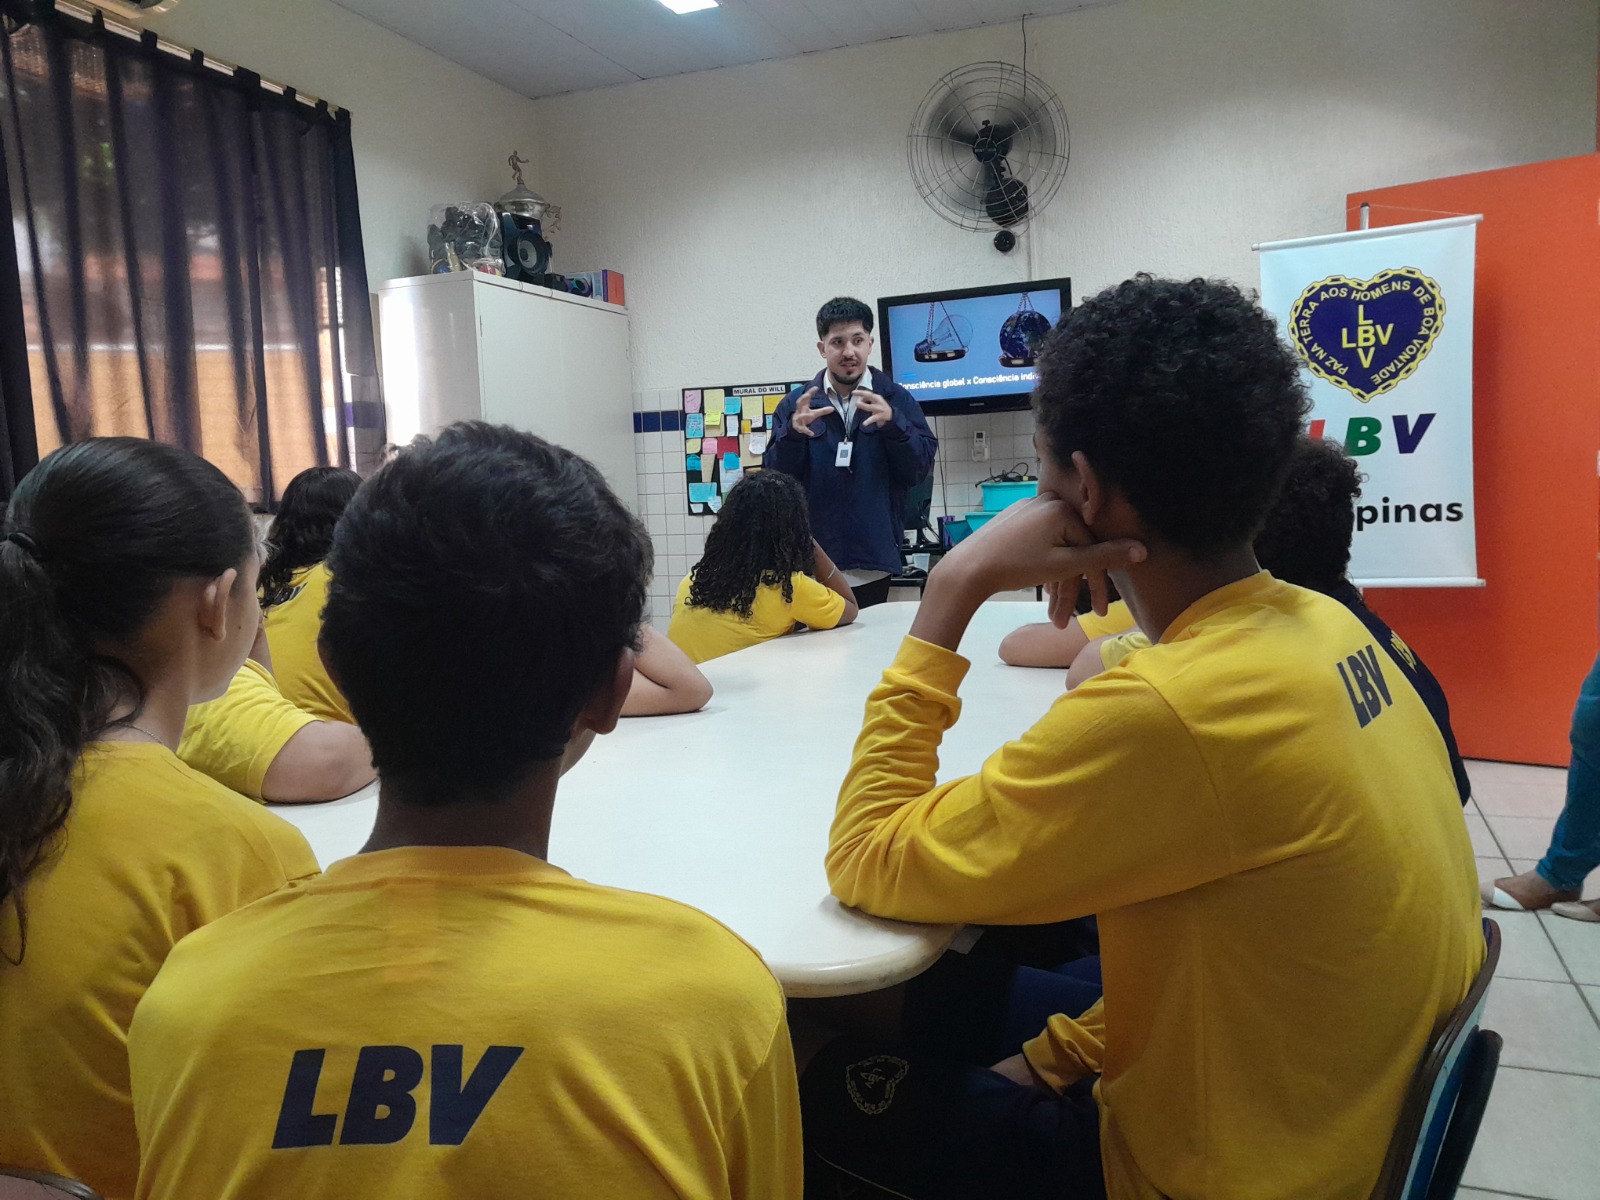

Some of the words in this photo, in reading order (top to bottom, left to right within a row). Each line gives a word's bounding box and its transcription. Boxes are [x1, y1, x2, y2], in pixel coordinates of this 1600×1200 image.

[1320, 287, 1347, 301] AOS
[1350, 280, 1411, 301] HOMENS
[1413, 286, 1432, 305] DE
[1299, 300, 1320, 345] TERRA
[1418, 307, 1435, 336] BOA
[1341, 323, 1394, 348] LBV
[1310, 342, 1327, 361] NA
[1370, 338, 1424, 385] VONTADE
[1324, 356, 1350, 376] PAZ
[733, 387, 757, 395] MURAL
[942, 377, 966, 389] global
[973, 373, 1019, 385] Consciência
[1356, 496, 1464, 532] pinas
[1336, 644, 1394, 729] LBV
[271, 1044, 525, 1149] LBV
